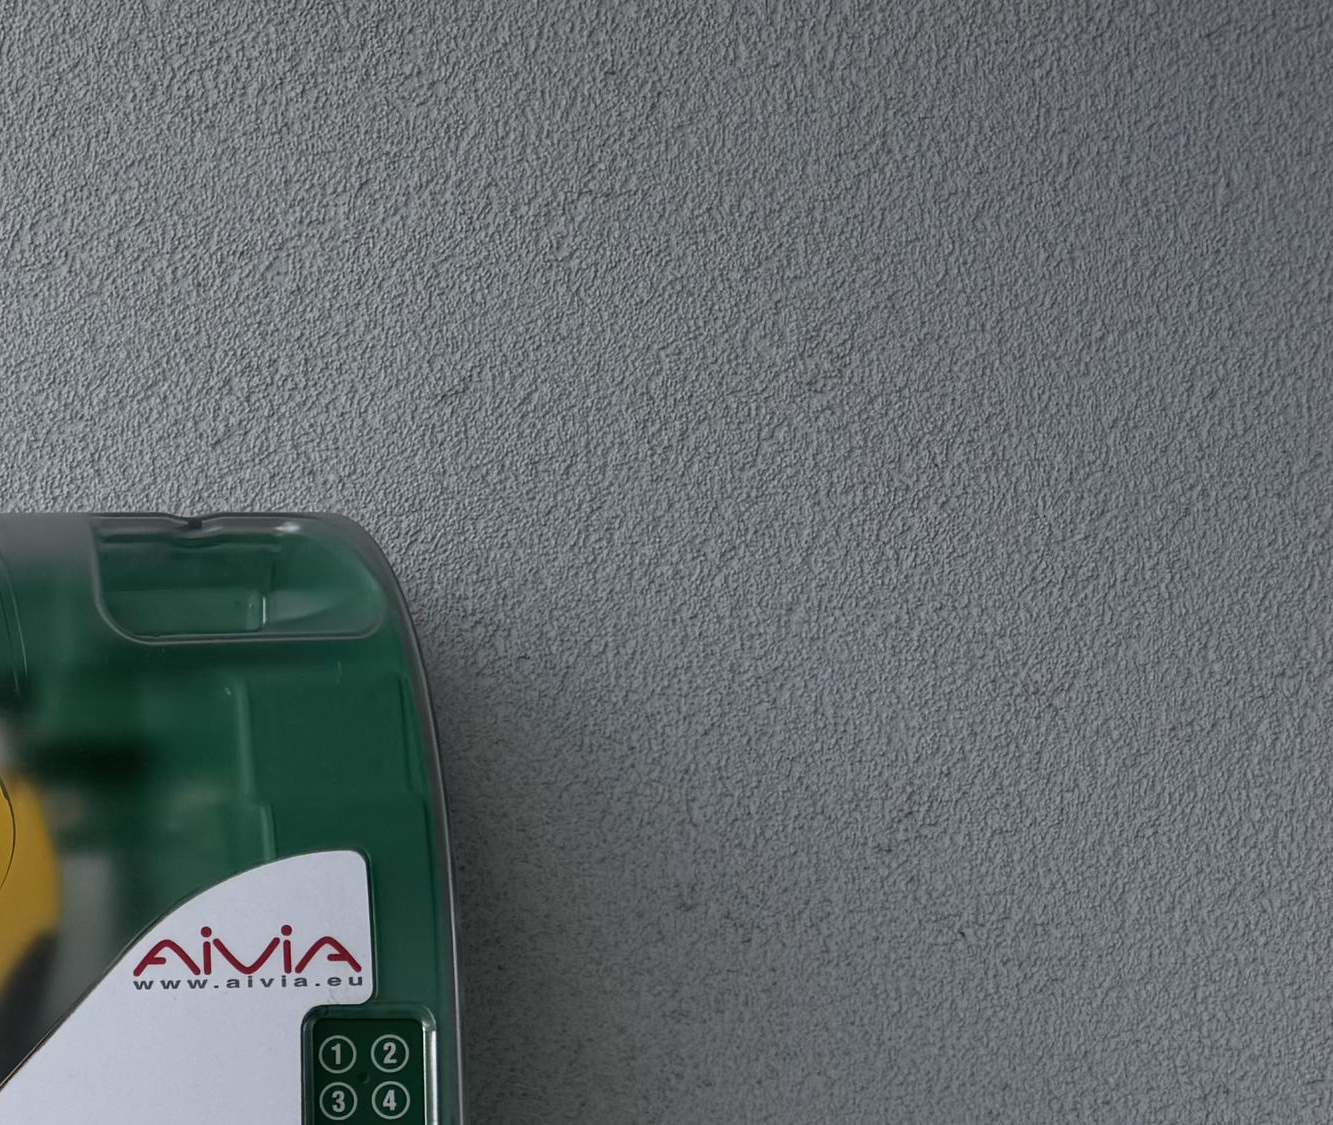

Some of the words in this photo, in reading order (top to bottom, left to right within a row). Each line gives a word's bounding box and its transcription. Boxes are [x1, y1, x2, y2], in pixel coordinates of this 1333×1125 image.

[133, 974, 363, 990] www.aivia.eu
[332, 1043, 342, 1065] 1
[383, 1042, 397, 1064] 2
[332, 1090, 346, 1112] 3
[382, 1089, 397, 1111] 4
